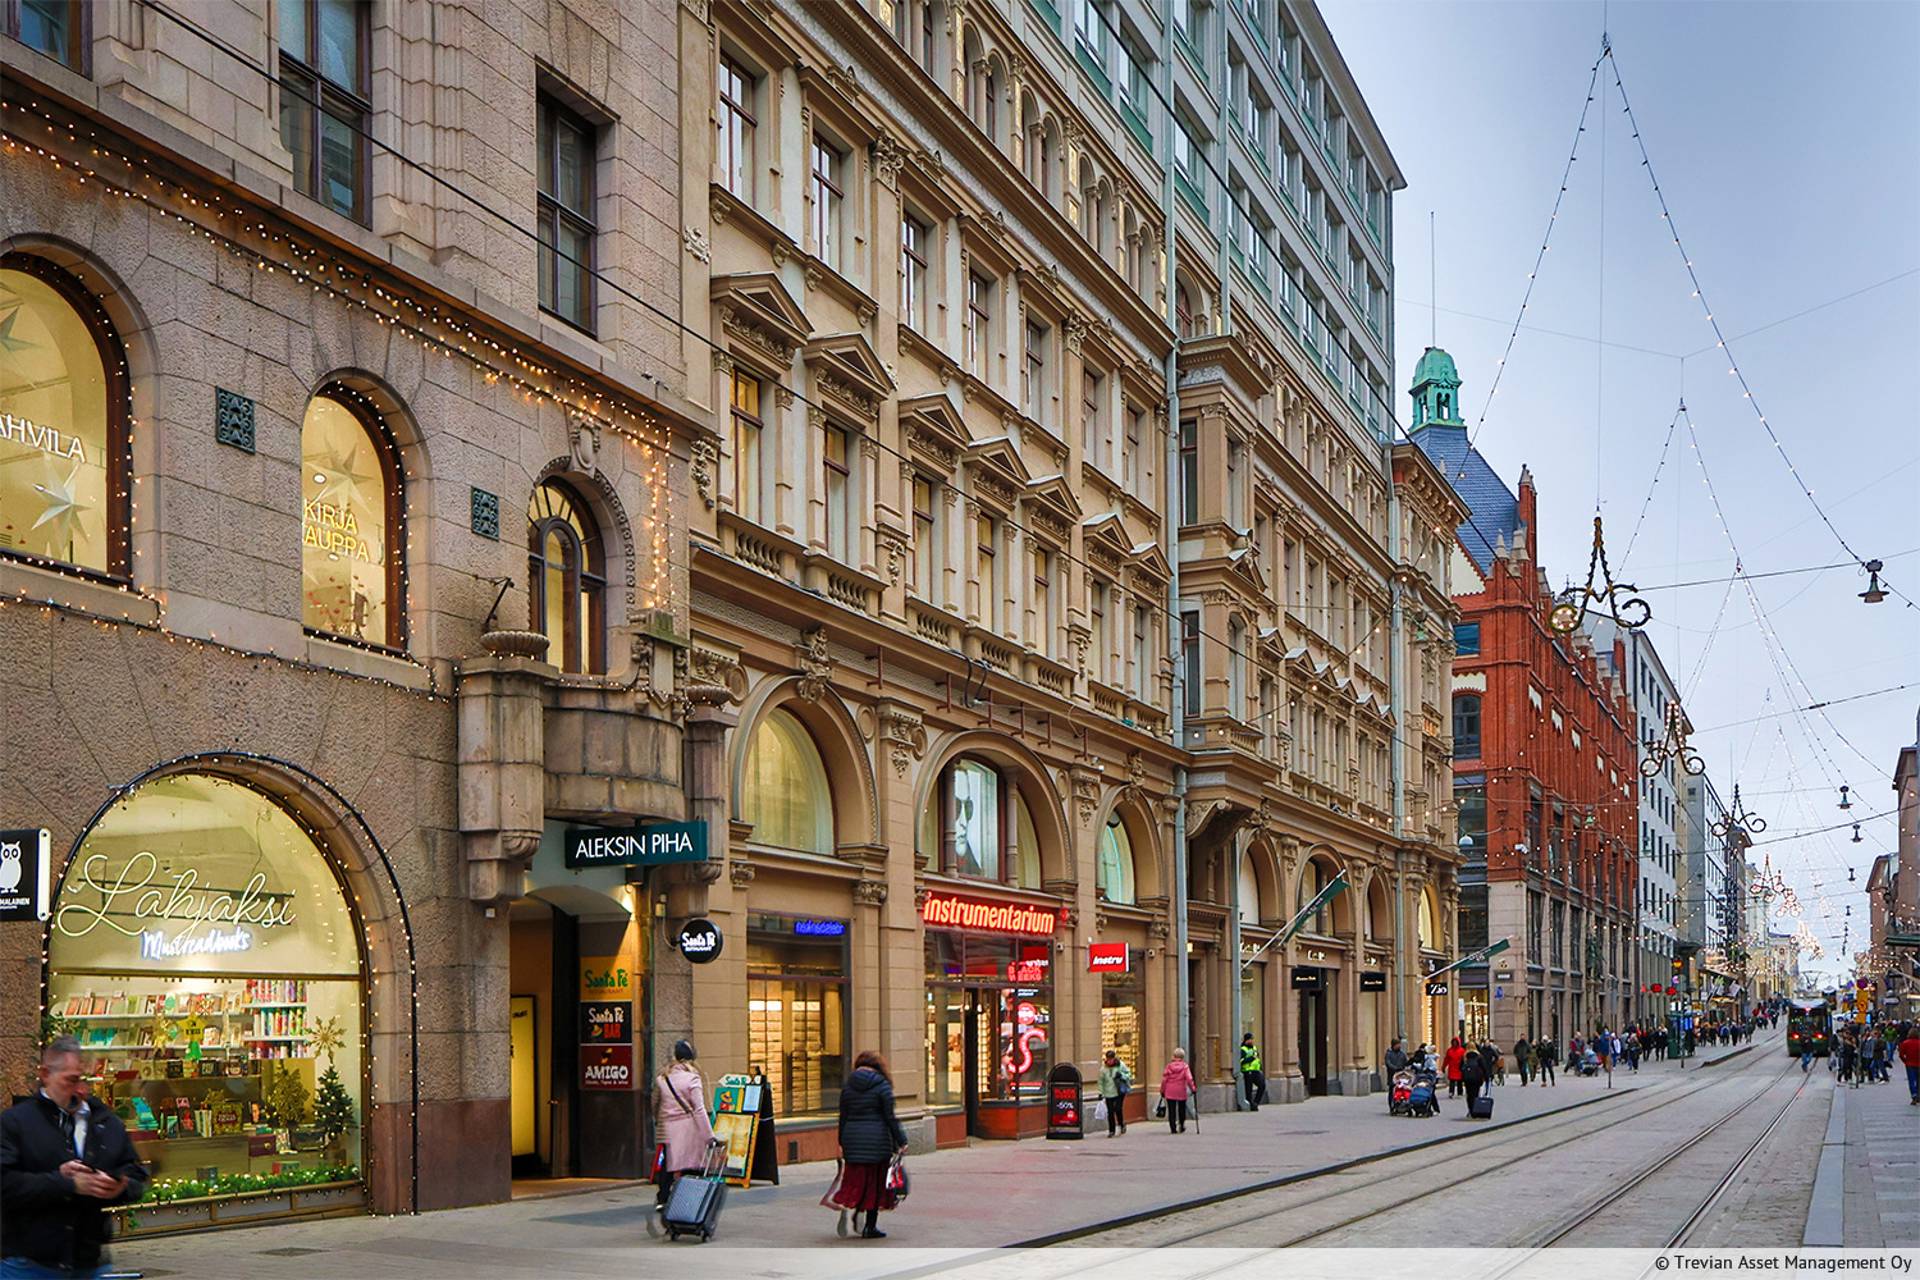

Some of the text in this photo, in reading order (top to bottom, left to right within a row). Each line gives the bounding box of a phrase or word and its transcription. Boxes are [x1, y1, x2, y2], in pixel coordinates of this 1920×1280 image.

[304, 498, 358, 535] KIRJA
[301, 524, 370, 562] AUPPA
[575, 831, 694, 859] ALEKSIN PIHA
[57, 851, 297, 949] Lahjaksi
[923, 891, 1055, 934] instrumentarium
[585, 968, 616, 988] Santa
[588, 1007, 614, 1023] Santa
[584, 1065, 629, 1080] AMIGO
